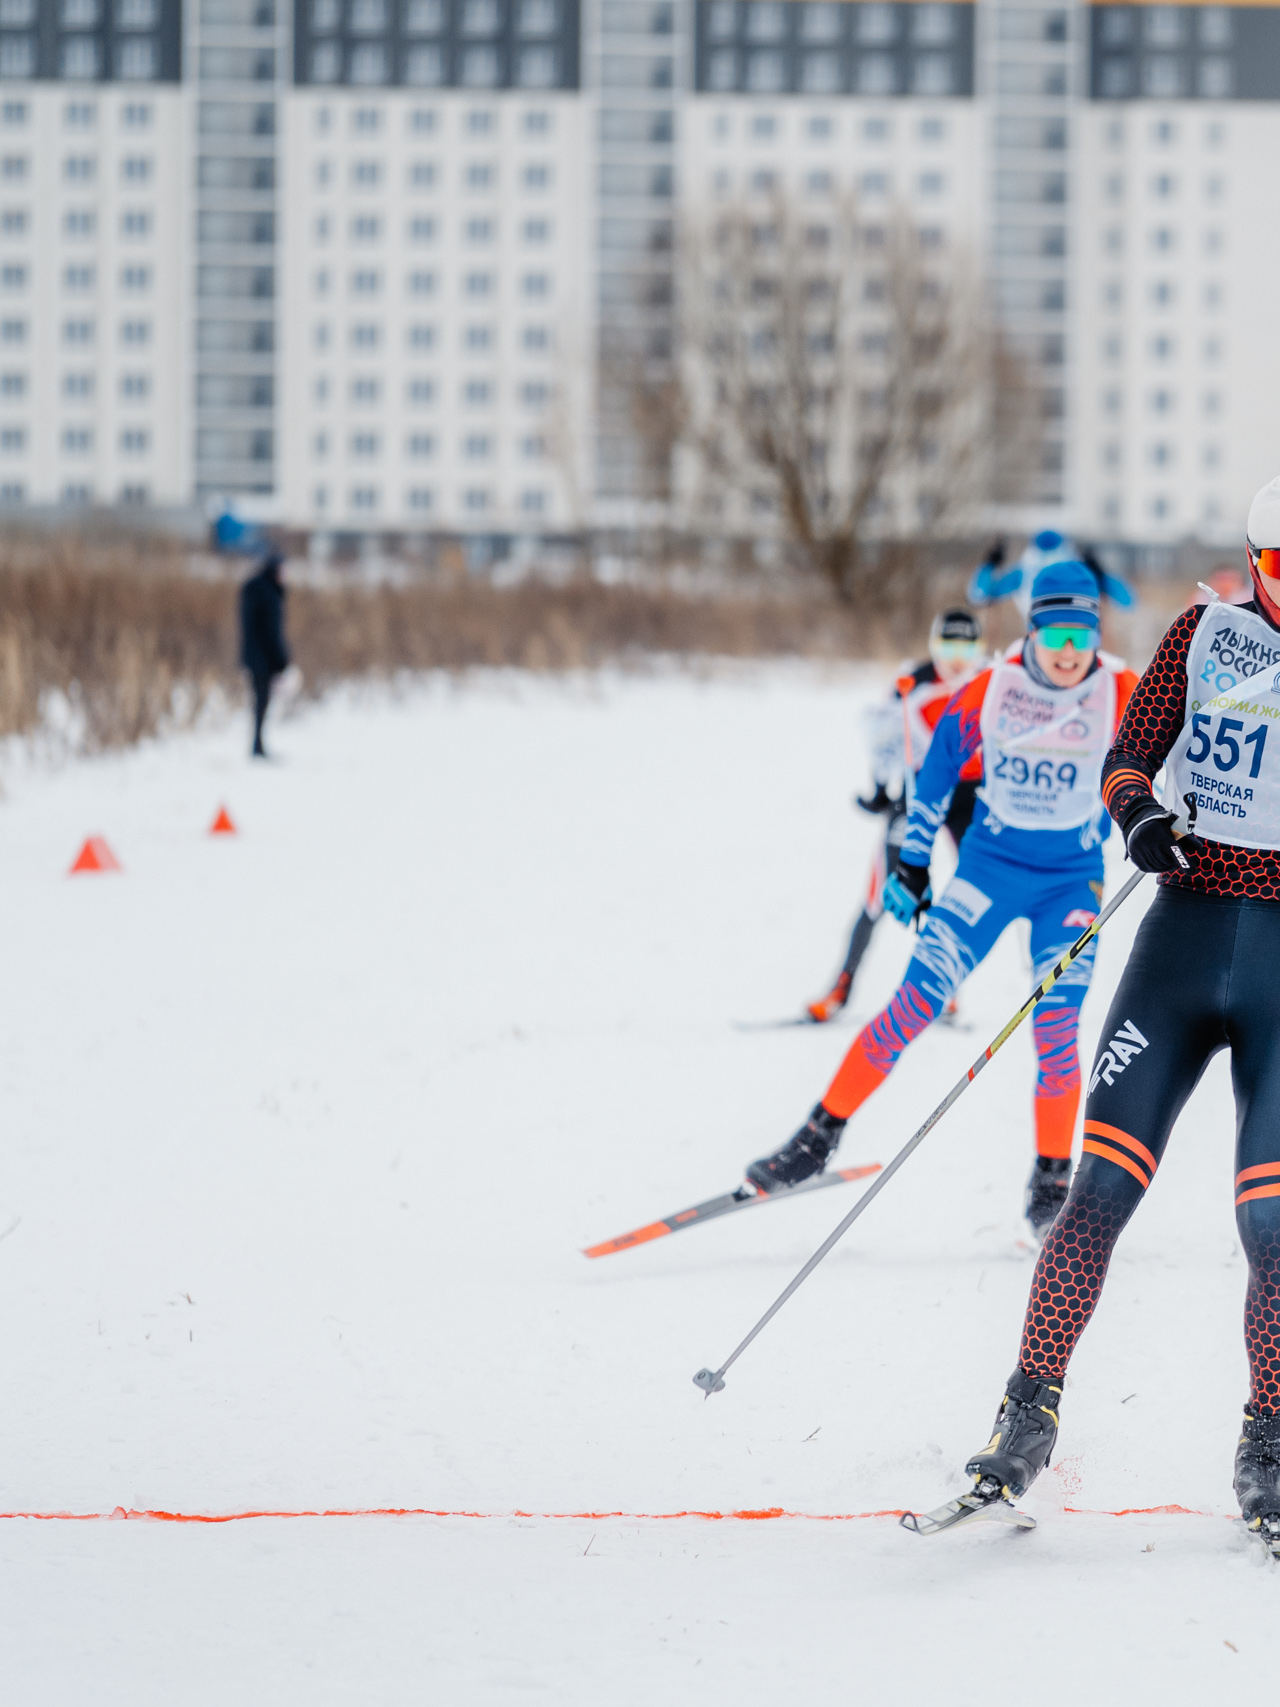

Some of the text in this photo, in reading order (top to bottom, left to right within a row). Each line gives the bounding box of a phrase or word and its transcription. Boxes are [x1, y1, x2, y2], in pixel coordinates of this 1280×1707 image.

[1200, 659, 1238, 693] 20
[1209, 637, 1267, 678] РОССИ
[1208, 696, 1257, 715] НОРМА
[1186, 713, 1268, 778] 551
[994, 750, 1077, 791] 2969
[1191, 771, 1253, 801] ТВЕРСКАЯ
[1088, 1019, 1149, 1096] RAY
